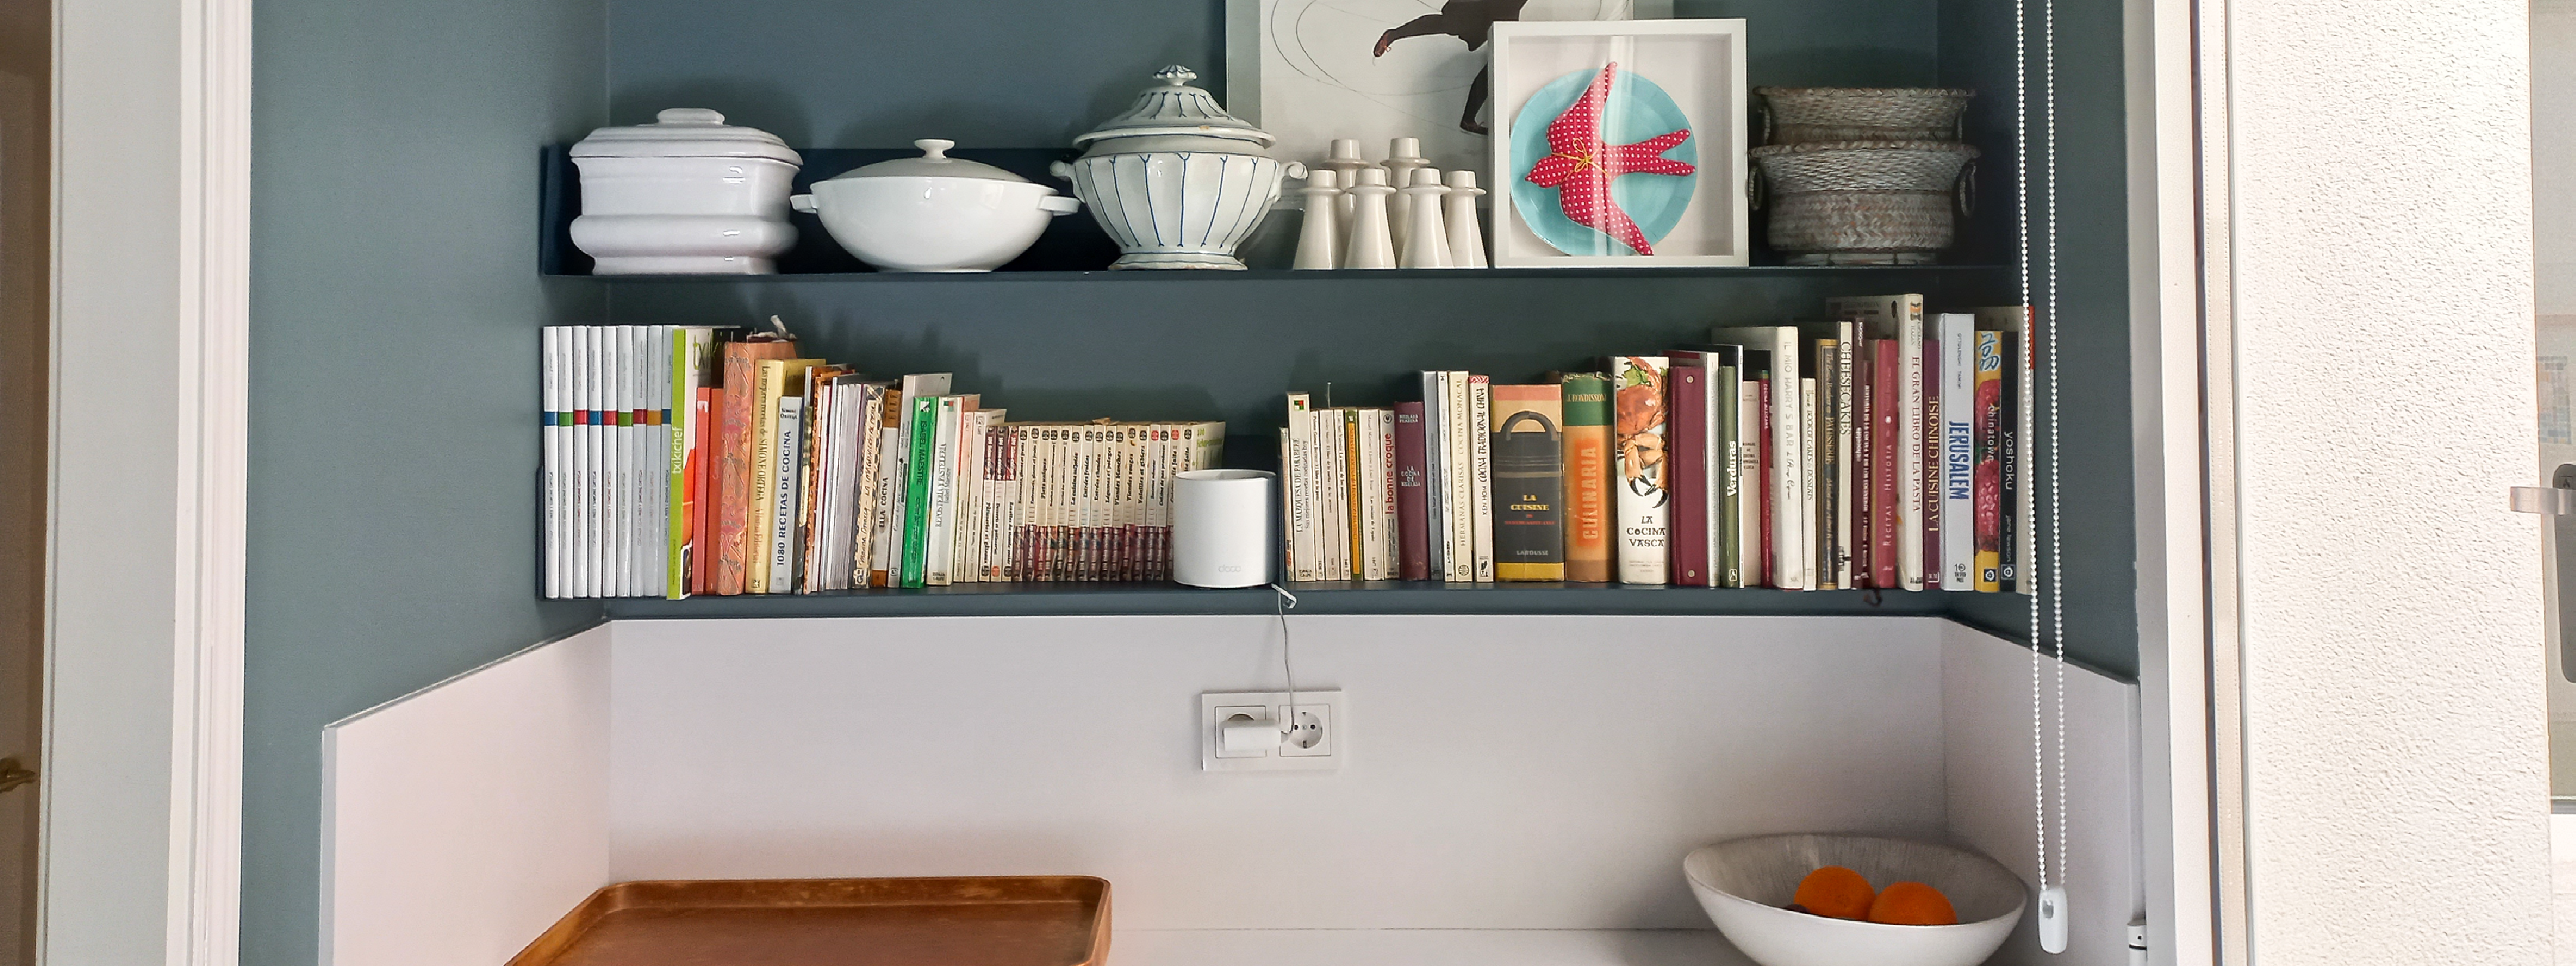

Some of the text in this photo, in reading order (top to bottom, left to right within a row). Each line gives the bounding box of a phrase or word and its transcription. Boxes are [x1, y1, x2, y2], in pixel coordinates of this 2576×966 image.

[1785, 341, 1791, 350] IL
[1840, 342, 1851, 435] CHEESECAKES
[671, 426, 683, 474] txikichef
[758, 439, 767, 469] SIMONE
[1384, 433, 1394, 469] croque
[1476, 388, 1488, 483] COCINA TRADICIONAL CHINA
[1912, 357, 1921, 513] EL GRAN LIBRO DE LA PASTA
[1987, 405, 1996, 462] chinatown
[916, 449, 925, 485] MAESTRE
[937, 443, 947, 482] PASTELERÍA
[1295, 474, 1301, 483] DE
[1727, 441, 1737, 497] Verduras
[1928, 395, 1939, 532] LA CUISINE CHINOISE
[1949, 421, 1969, 500] JERUSALEM
[2004, 431, 2015, 490] yoshoku
[756, 471, 766, 501] ORTEGA
[776, 430, 791, 566] 1080 RECETAS DE COCINA
[1385, 471, 1394, 504] bonne
[1581, 447, 1599, 539] CULINARIA
[1884, 444, 1892, 546] RECETAS HISTORIA
[935, 489, 944, 527] REPOSTERÍA
[1385, 506, 1394, 514] la
[1641, 516, 1653, 524] LA
[1626, 527, 1665, 536] COCINA
